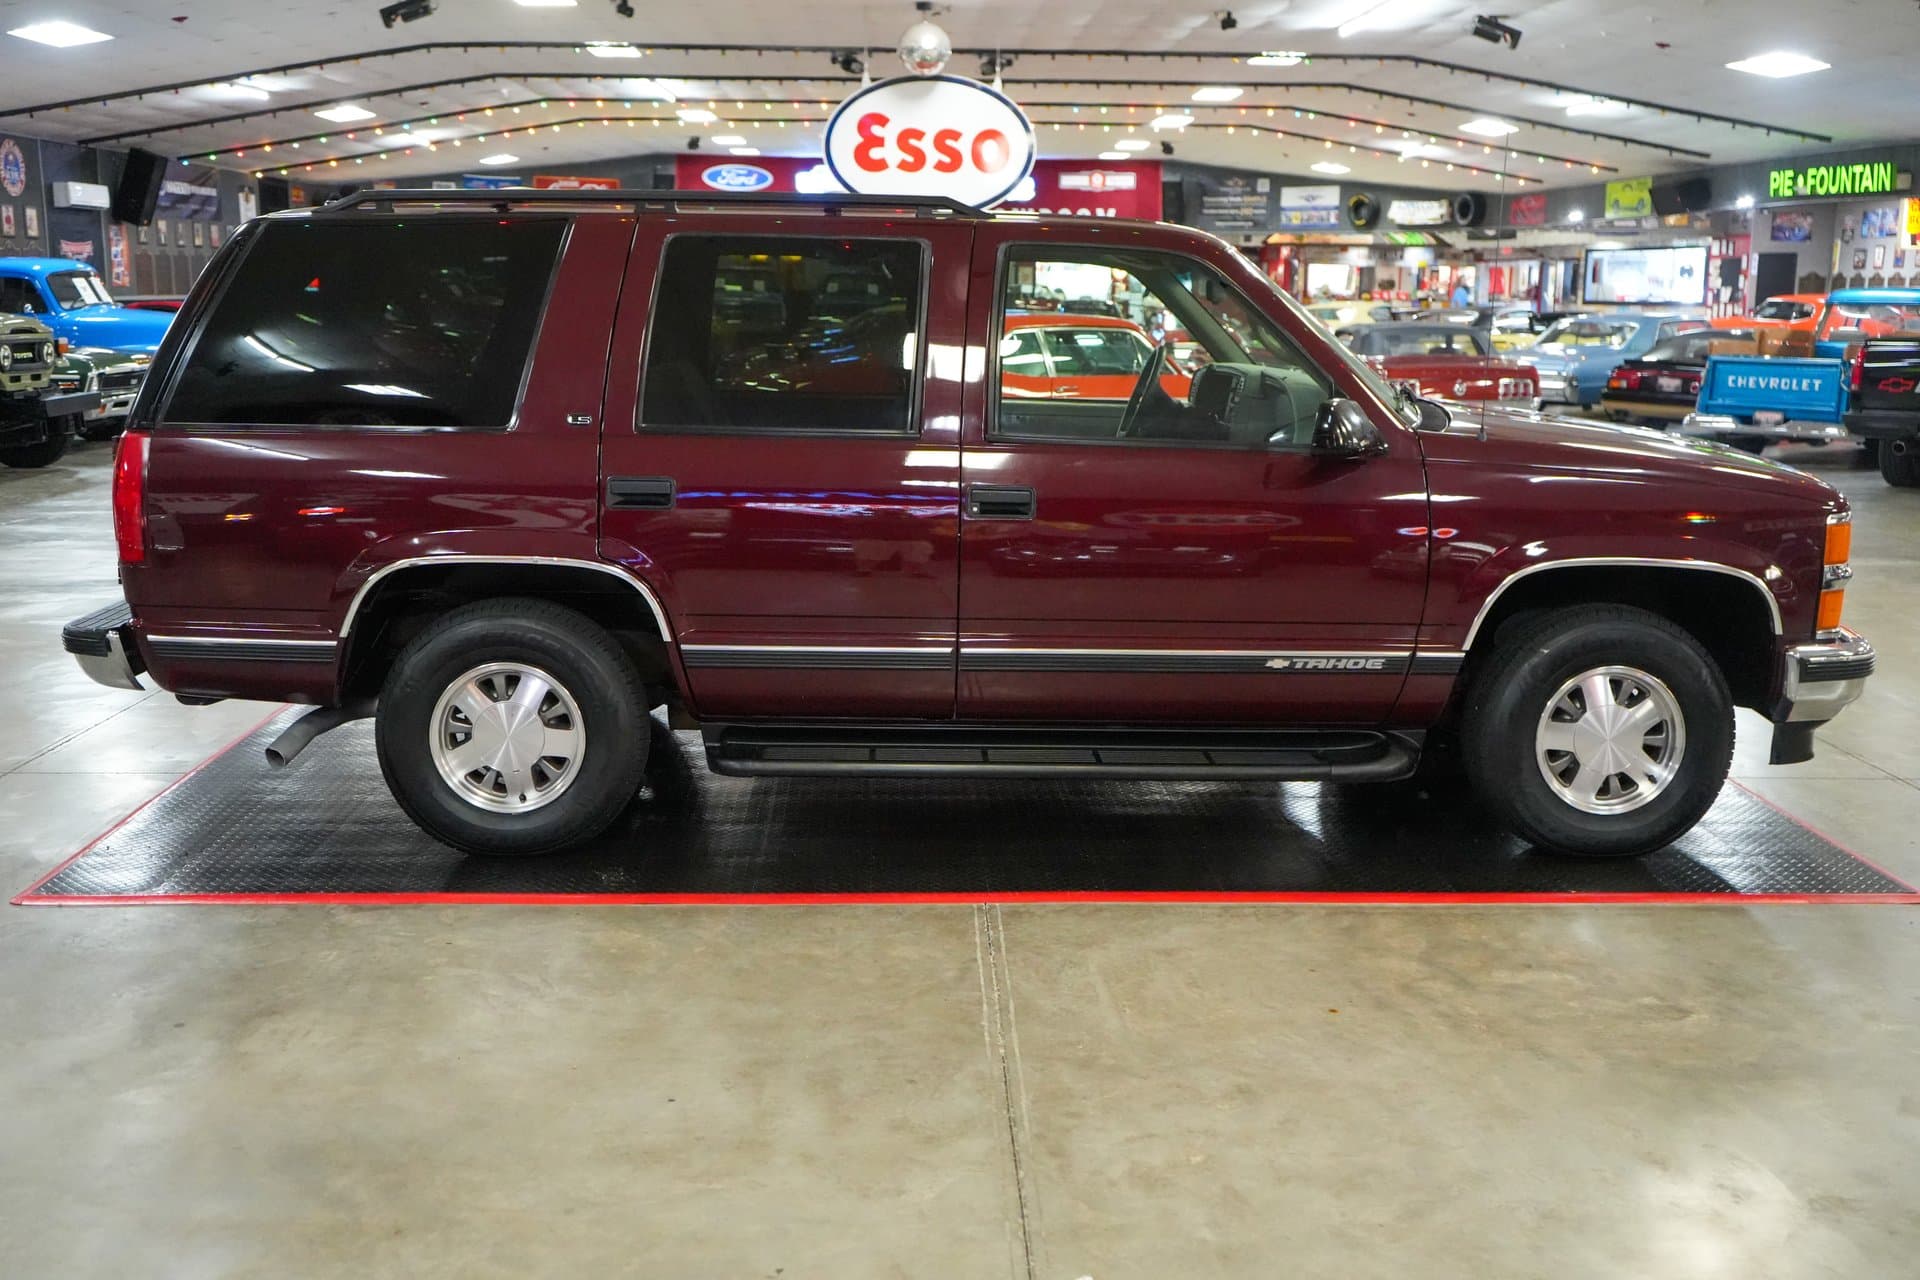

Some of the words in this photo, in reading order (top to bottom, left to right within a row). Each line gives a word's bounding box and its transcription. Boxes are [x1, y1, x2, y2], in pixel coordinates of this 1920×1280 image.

[853, 112, 1010, 173] Esso
[717, 168, 758, 185] Ford
[1769, 169, 1795, 197] PIE
[1806, 162, 1892, 195] FOUNTAIN
[1728, 375, 1822, 391] CHEVROLET
[1292, 658, 1386, 669] TAHOE
